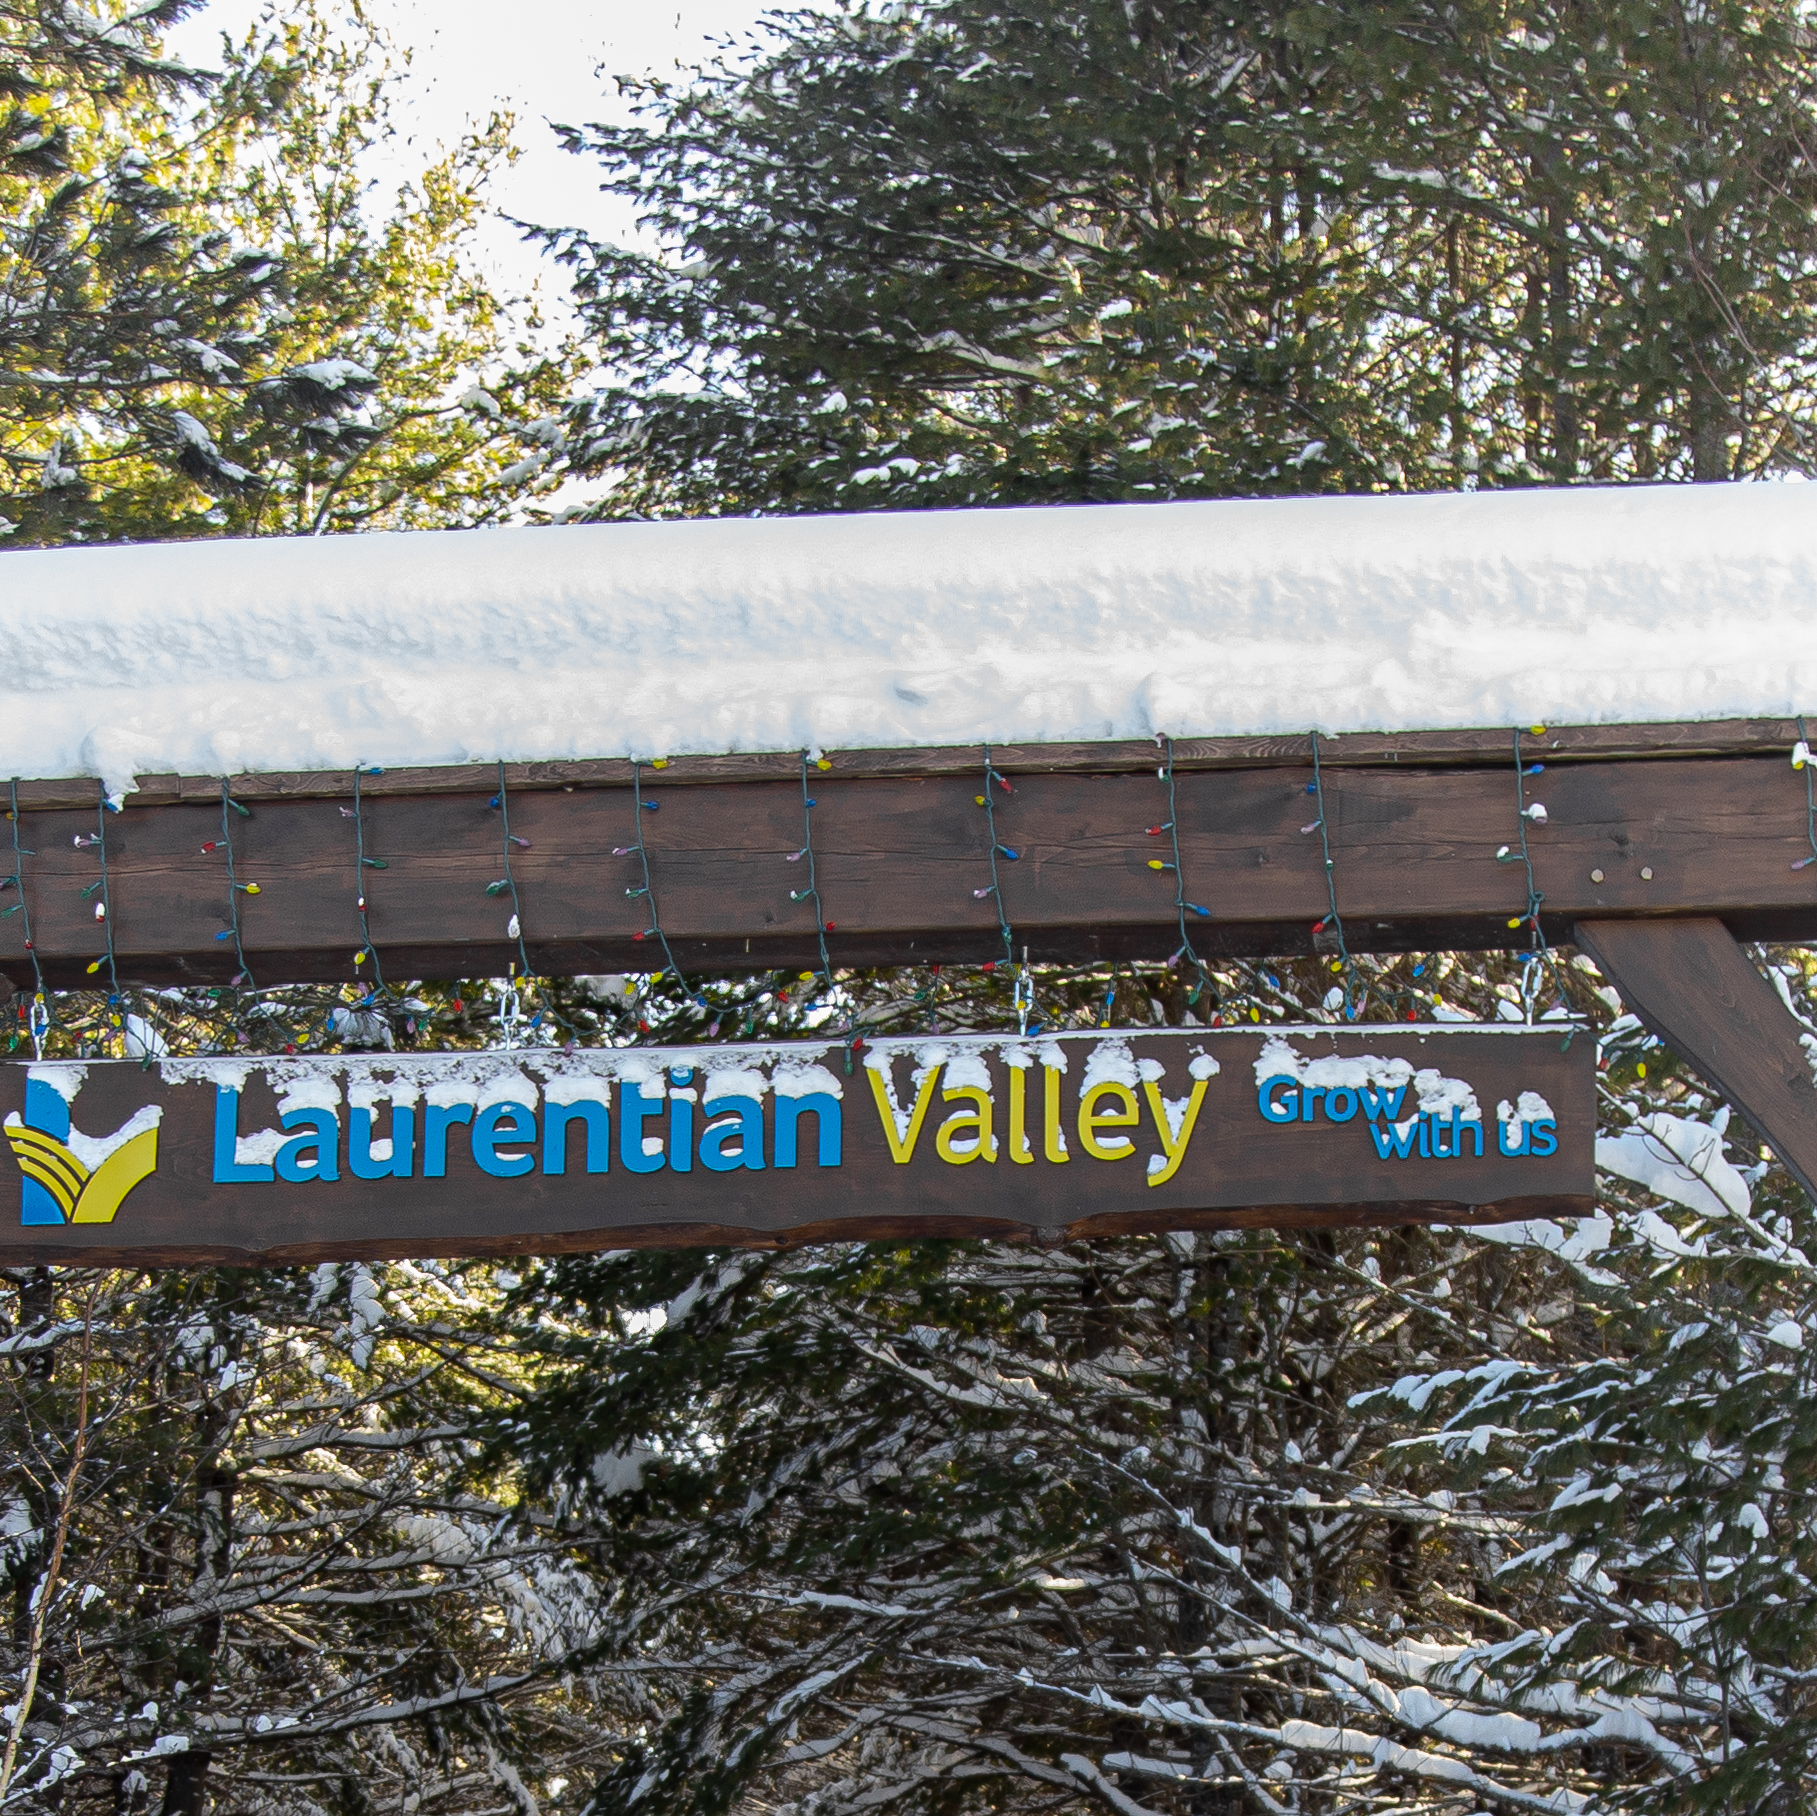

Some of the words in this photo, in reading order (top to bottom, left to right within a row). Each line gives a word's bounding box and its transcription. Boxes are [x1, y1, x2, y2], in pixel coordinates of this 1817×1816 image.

[213, 1066, 842, 1184] Laurentian
[865, 1063, 1210, 1188] Valley
[1258, 1074, 1407, 1123] Grow
[1369, 1105, 1484, 1159] with
[1498, 1118, 1559, 1157] us
